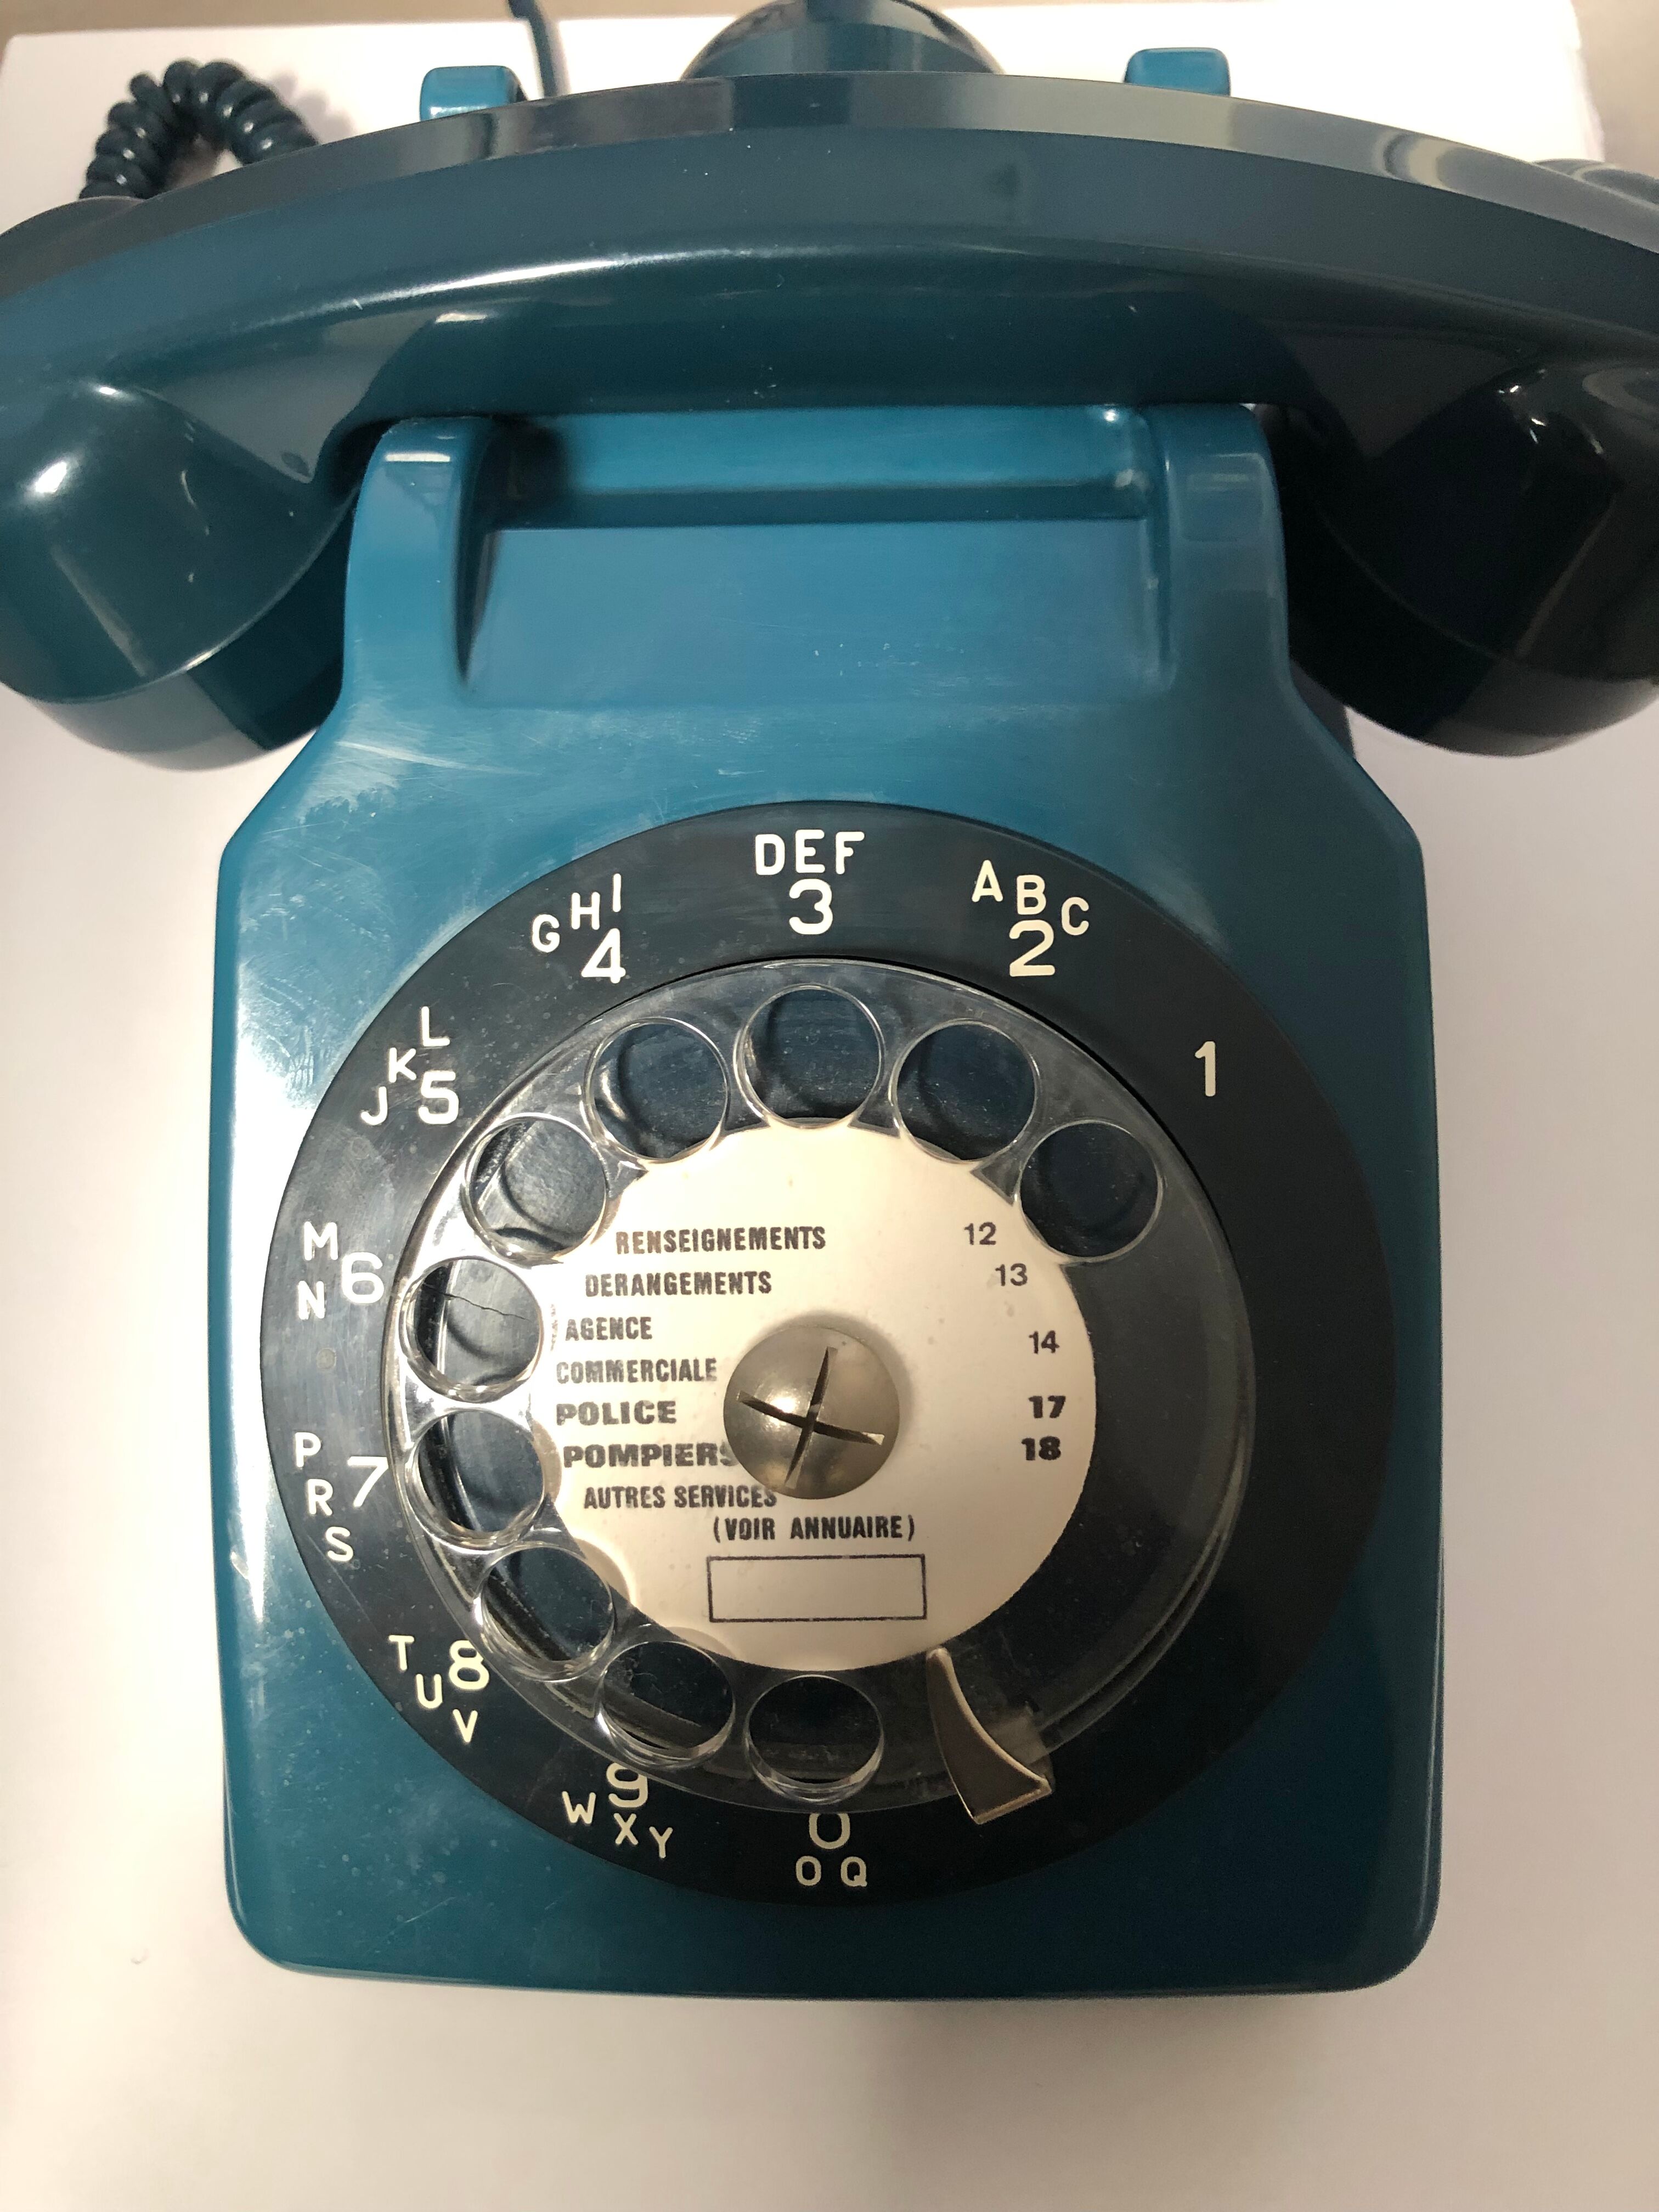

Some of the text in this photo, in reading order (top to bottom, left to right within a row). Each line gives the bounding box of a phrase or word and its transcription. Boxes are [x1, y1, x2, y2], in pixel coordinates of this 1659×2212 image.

[754, 829, 865, 876] DEF
[788, 878, 833, 935] 3
[581, 928, 626, 984] 4
[1009, 919, 1056, 977] 2
[1194, 1041, 1216, 1097] 1
[419, 1071, 459, 1125] 5
[616, 1222, 997, 1255] RENSEIGNEMENTS 12
[341, 1252, 385, 1304] 6
[585, 1263, 1028, 1297] DERANGEMENTS 13
[565, 1316, 652, 1341] AGENCE
[556, 1330, 1060, 1384] COMMERCIALE 14
[556, 1396, 1066, 1426] POLICE 17
[1022, 1437, 1062, 1461] 18
[347, 1456, 389, 1508] 7
[584, 1485, 777, 1509] AUTRES SERVICES
[448, 1639, 490, 1691] 8
[606, 1762, 648, 1808] 9
